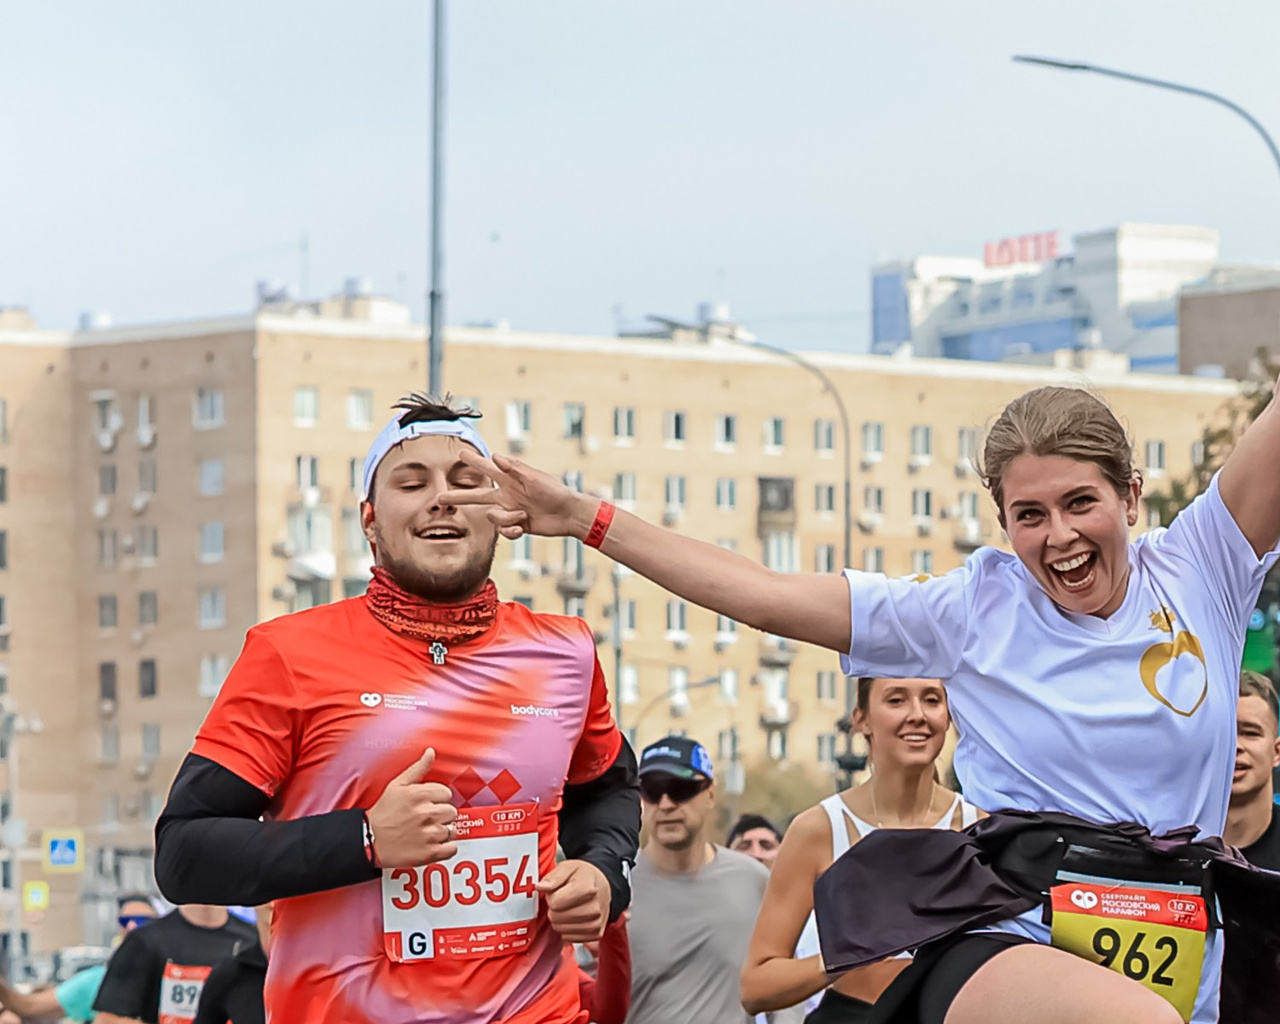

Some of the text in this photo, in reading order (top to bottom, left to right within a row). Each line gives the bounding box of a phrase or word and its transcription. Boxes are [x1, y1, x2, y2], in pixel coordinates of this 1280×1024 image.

[984, 231, 1058, 268] LOTTE
[510, 703, 559, 718] bodycore
[496, 812, 506, 821] 10
[451, 818, 485, 829] ОВСКИЙ
[390, 855, 536, 910] 30354
[1101, 893, 1146, 902] СБЕРПРАЙМ
[1101, 900, 1161, 912] МОСКОВСКИЙ
[1173, 901, 1183, 910] 10
[1102, 907, 1147, 917] МАРАФОН
[408, 931, 427, 956] G
[1092, 927, 1179, 987] 962
